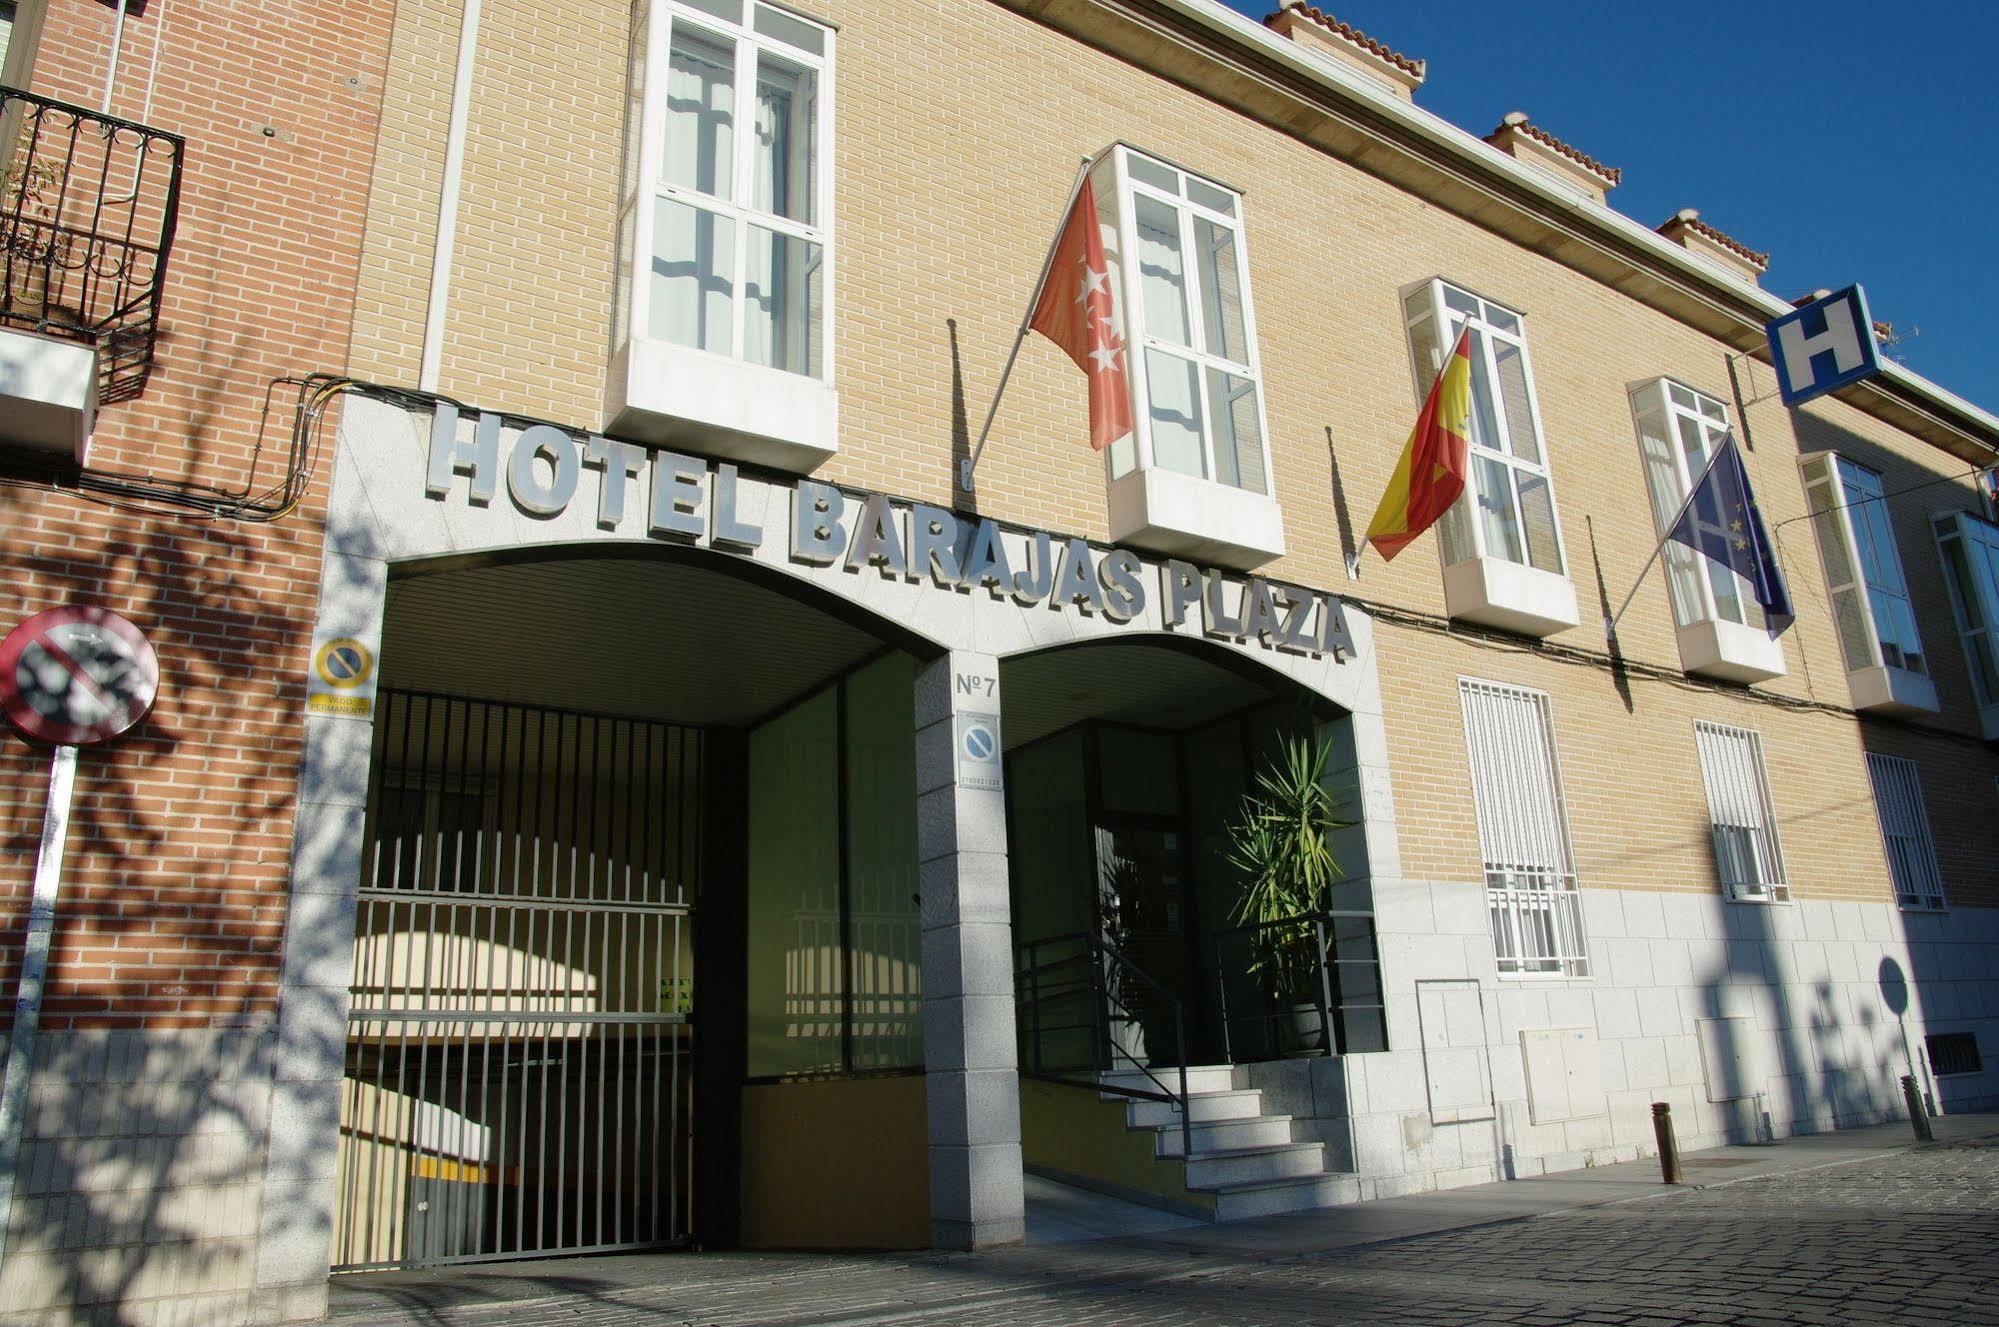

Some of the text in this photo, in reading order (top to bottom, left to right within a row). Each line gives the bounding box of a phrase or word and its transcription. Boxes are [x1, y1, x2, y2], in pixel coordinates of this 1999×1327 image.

[1778, 297, 1864, 393] H
[427, 401, 1358, 661] HOTEL BARAJAS PLAZA
[984, 677, 996, 697] 7
[311, 704, 369, 716] PERMANENTE
[329, 695, 353, 705] VADO
